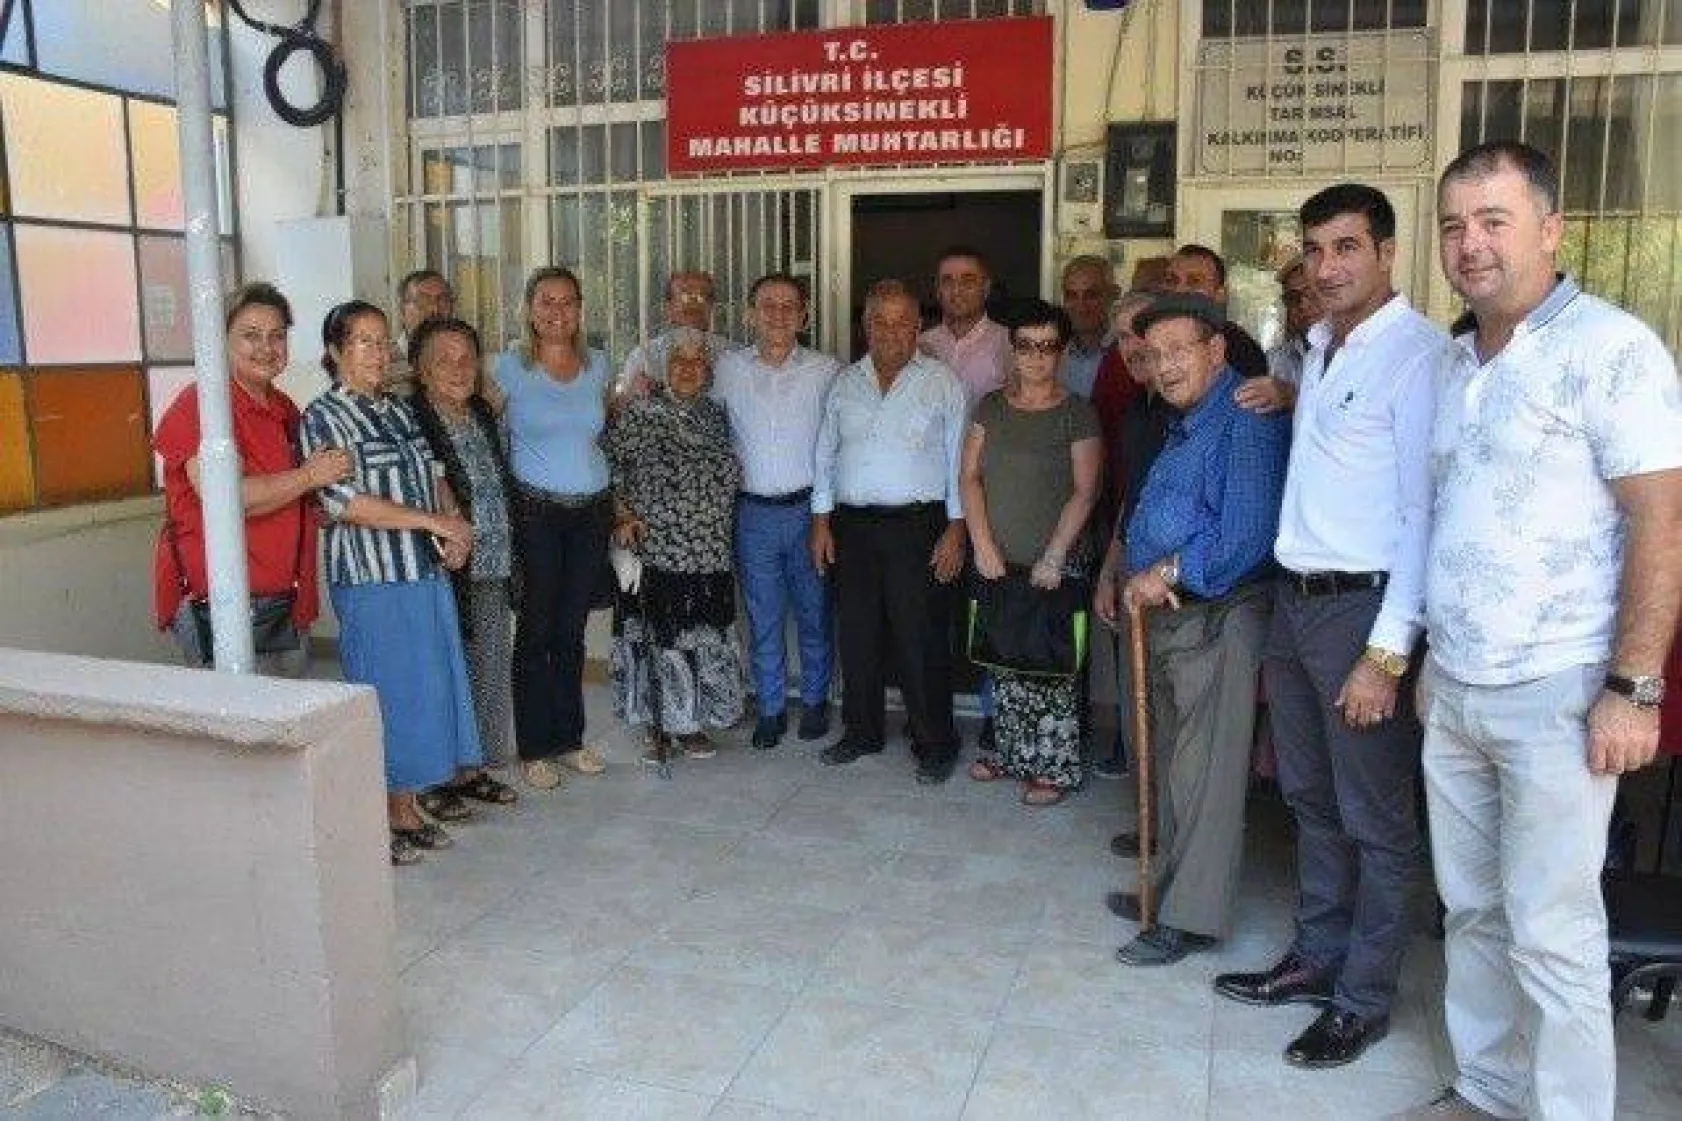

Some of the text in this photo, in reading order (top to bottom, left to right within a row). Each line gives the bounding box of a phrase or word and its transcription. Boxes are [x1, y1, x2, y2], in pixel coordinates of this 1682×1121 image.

[824, 40, 878, 61] T.C.
[744, 61, 963, 96] SİLİVRİ İLÇESİ
[739, 96, 968, 129] KÜÇÜKSİNEKLİ
[1271, 105, 1357, 121] TARMSAL
[688, 123, 1025, 158] MAHALLE MUHTARLIĞI
[1306, 121, 1423, 142] KOOERATİFİ
